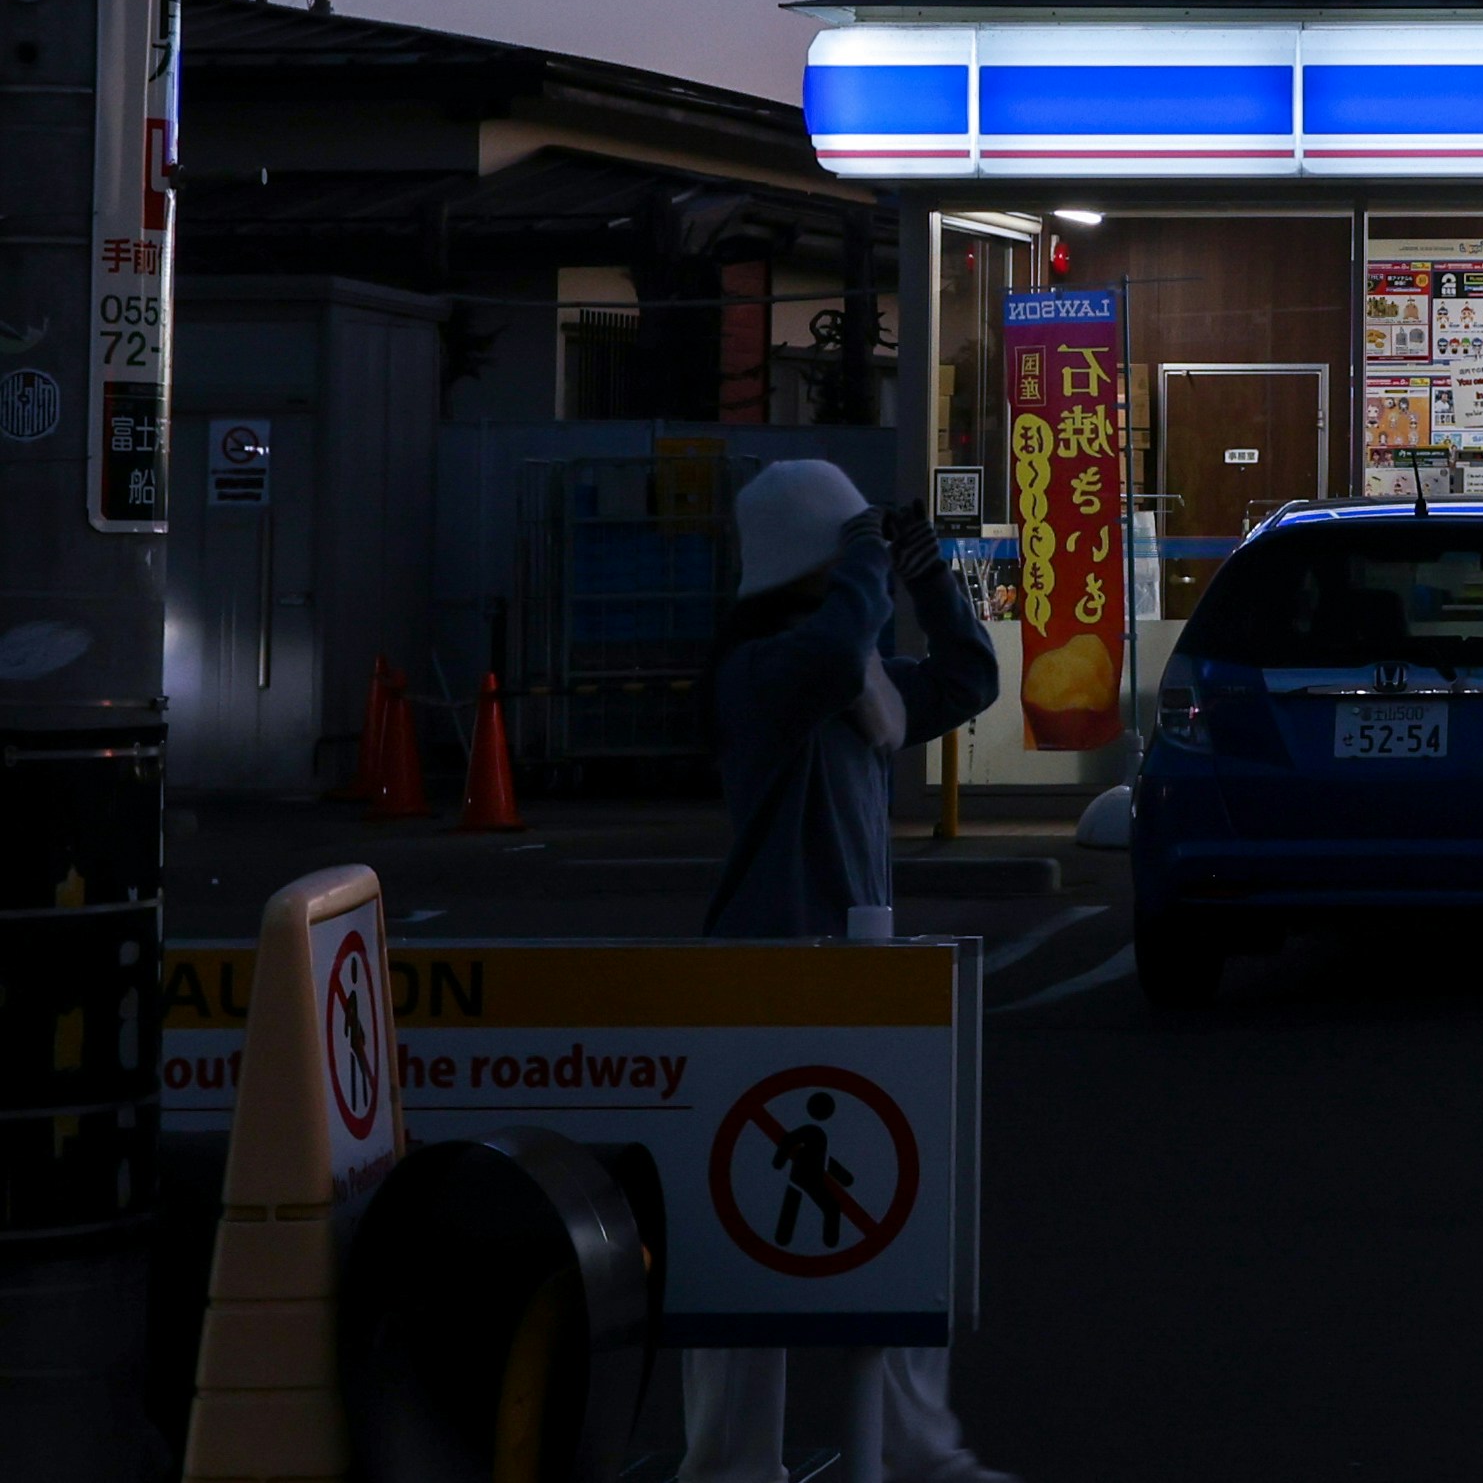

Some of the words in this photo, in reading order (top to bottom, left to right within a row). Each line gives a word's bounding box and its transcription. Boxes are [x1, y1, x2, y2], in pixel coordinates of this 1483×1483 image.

[101, 238, 164, 276] 手前
[1360, 725, 1440, 753] 52-54
[400, 1043, 456, 1090] he
[470, 1043, 688, 1100] roadway
